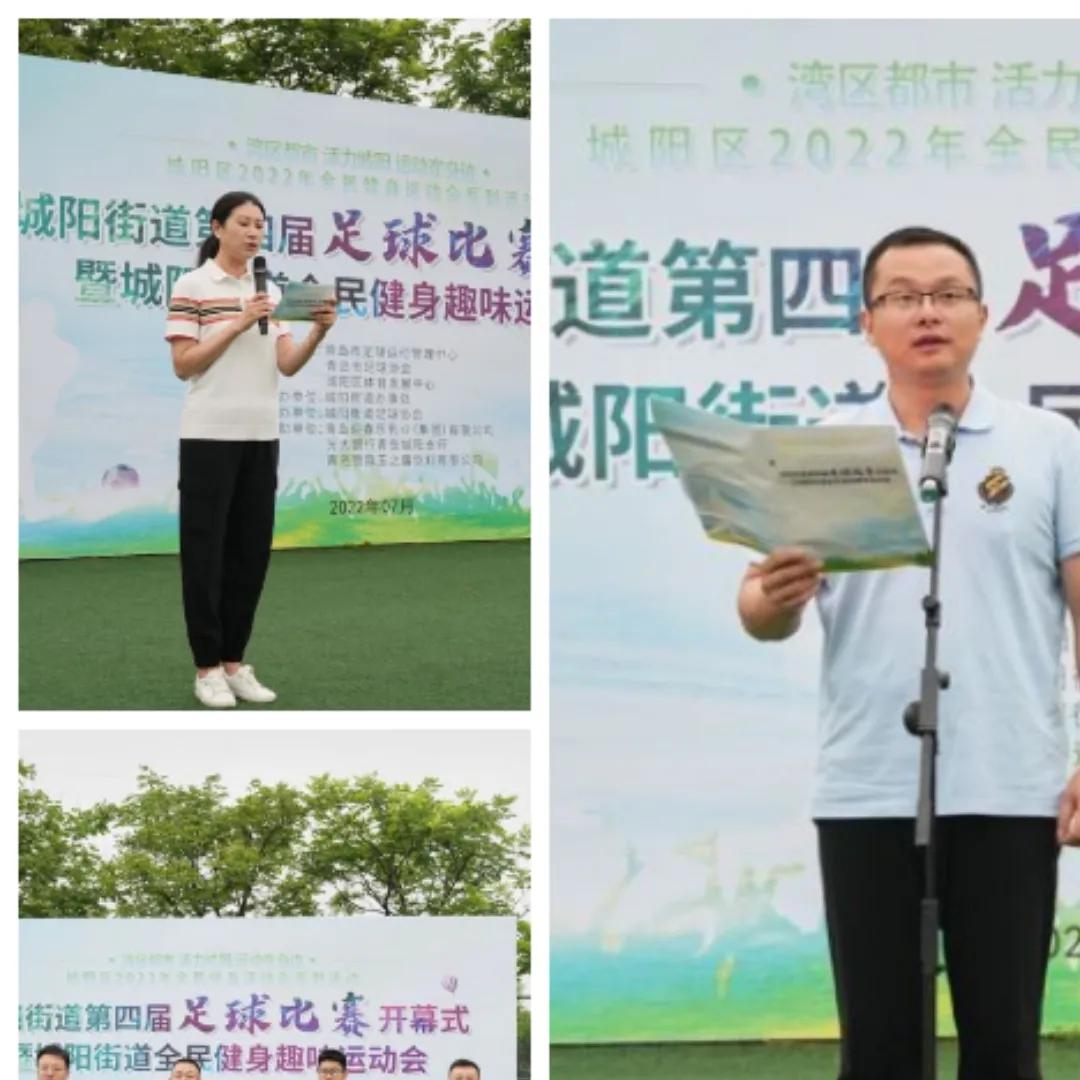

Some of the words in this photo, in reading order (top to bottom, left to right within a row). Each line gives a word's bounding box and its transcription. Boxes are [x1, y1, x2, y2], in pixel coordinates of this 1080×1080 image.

[789, 60, 976, 110] 湾区都市
[550, 237, 863, 339] 道第四
[19, 1002, 171, 1034] 街道第四届
[179, 992, 368, 1038] 足球比赛
[379, 1004, 470, 1036] 开幕式
[19, 1042, 429, 1075] 阳街道全民健身趣运动会
